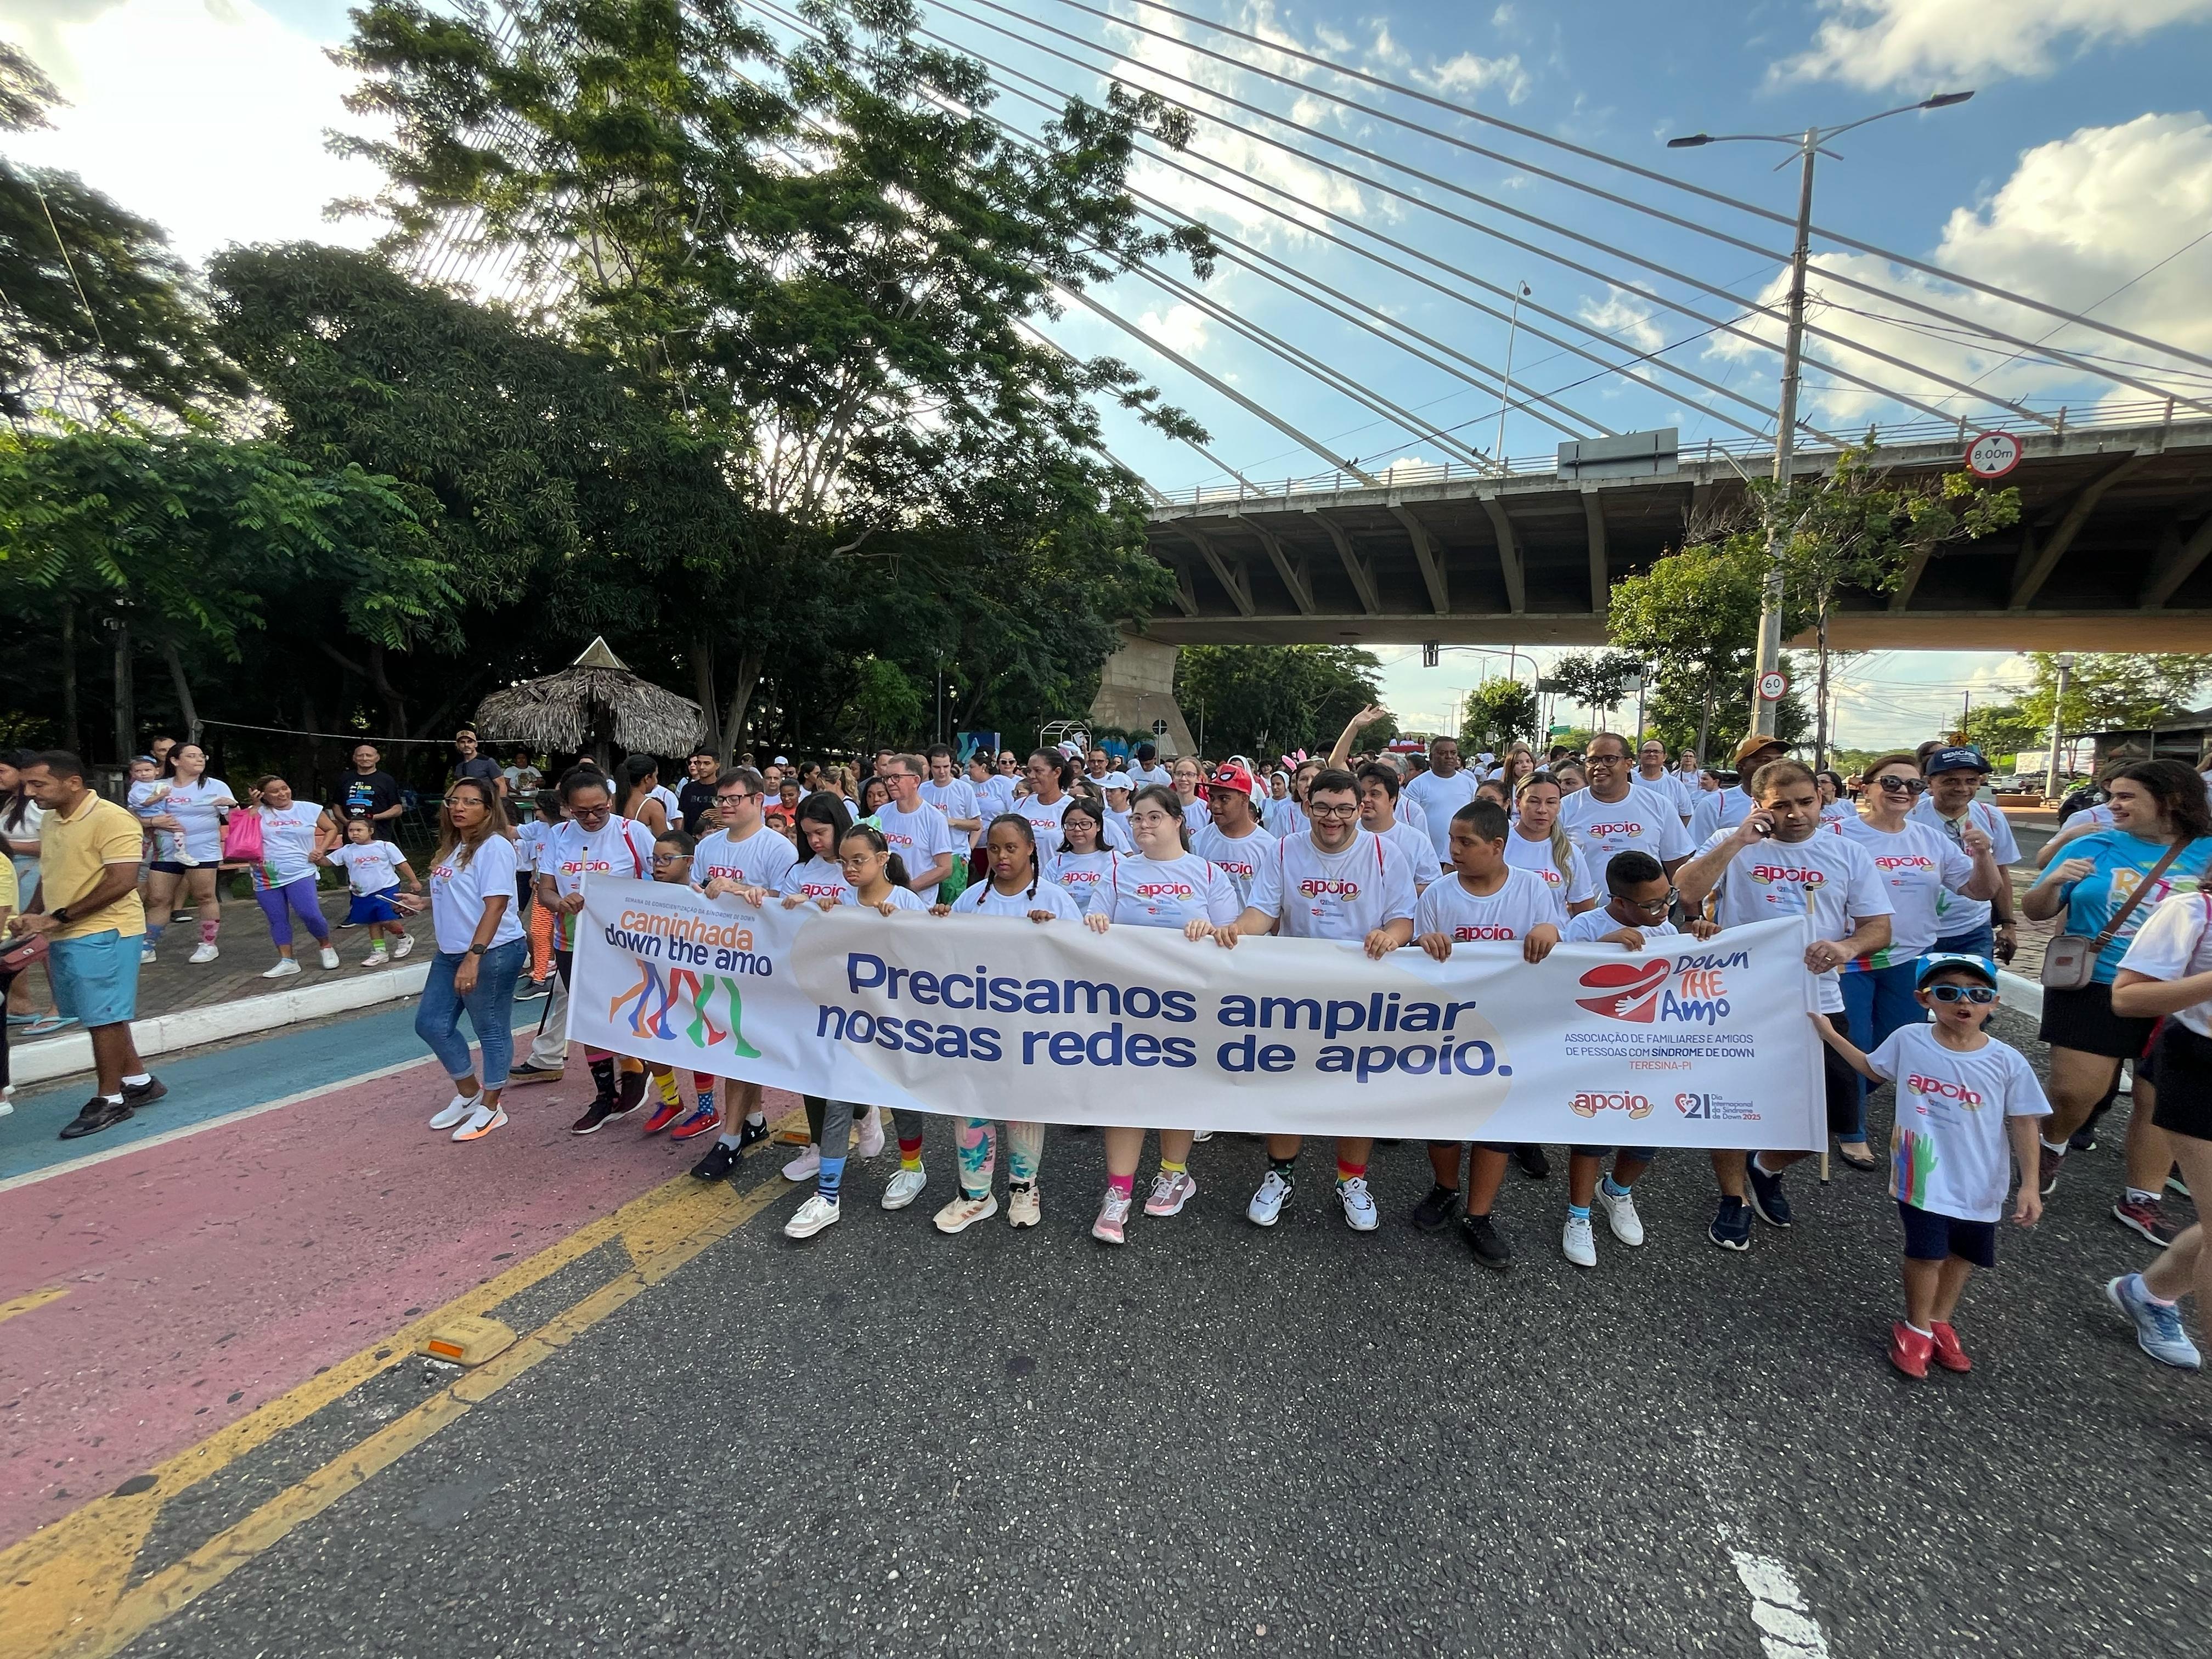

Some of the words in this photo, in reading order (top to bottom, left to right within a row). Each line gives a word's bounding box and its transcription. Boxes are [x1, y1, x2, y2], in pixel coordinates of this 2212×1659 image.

[1974, 449, 2012, 459] 8.00m
[1765, 679, 1780, 688] 60
[1591, 821, 1640, 836] apoio
[1875, 855, 1932, 867] apoio
[708, 865, 743, 878] apoio
[1062, 871, 1101, 883] apoio
[1753, 866, 1824, 882] apoio
[1137, 882, 1192, 898] apoio
[1301, 879, 1357, 897] apoio
[652, 901, 697, 913] CONSCIENTIZAÇÃO
[706, 909, 732, 919] SÍNDROME
[620, 910, 754, 951] caminhada
[1455, 924, 1514, 942] apoio
[605, 923, 661, 957] down
[668, 934, 708, 966] the
[715, 949, 772, 977] amo
[1678, 968, 1728, 1000] THE
[847, 952, 1197, 1023] Precisamos
[1217, 992, 1476, 1040] ampliar
[816, 1005, 1003, 1062] nossas
[1023, 1022, 1197, 1068] redes
[1216, 1034, 1296, 1073] de
[1315, 1035, 1513, 1084] apoio.
[1565, 1032, 1629, 1045] ASSOCIAÇÃO
[1631, 1034, 1645, 1043] DE
[1647, 1034, 1705, 1043] FAMILIARES
[1707, 1034, 1713, 1043] E
[1714, 1034, 1753, 1043] AMIGOS
[1566, 1047, 1579, 1056] DE
[1581, 1047, 1627, 1057] PESSOAS
[1629, 1048, 1650, 1057] COM
[1651, 1046, 1704, 1057] SÍNDROME
[1706, 1048, 1720, 1057] DE
[1722, 1048, 1755, 1058] DOWN
[1629, 1060, 1692, 1070] TERESINA-PI
[1908, 1074, 1981, 1105] apoio
[1575, 1091, 1649, 1114] apoio
[1680, 1093, 1711, 1119] 21
